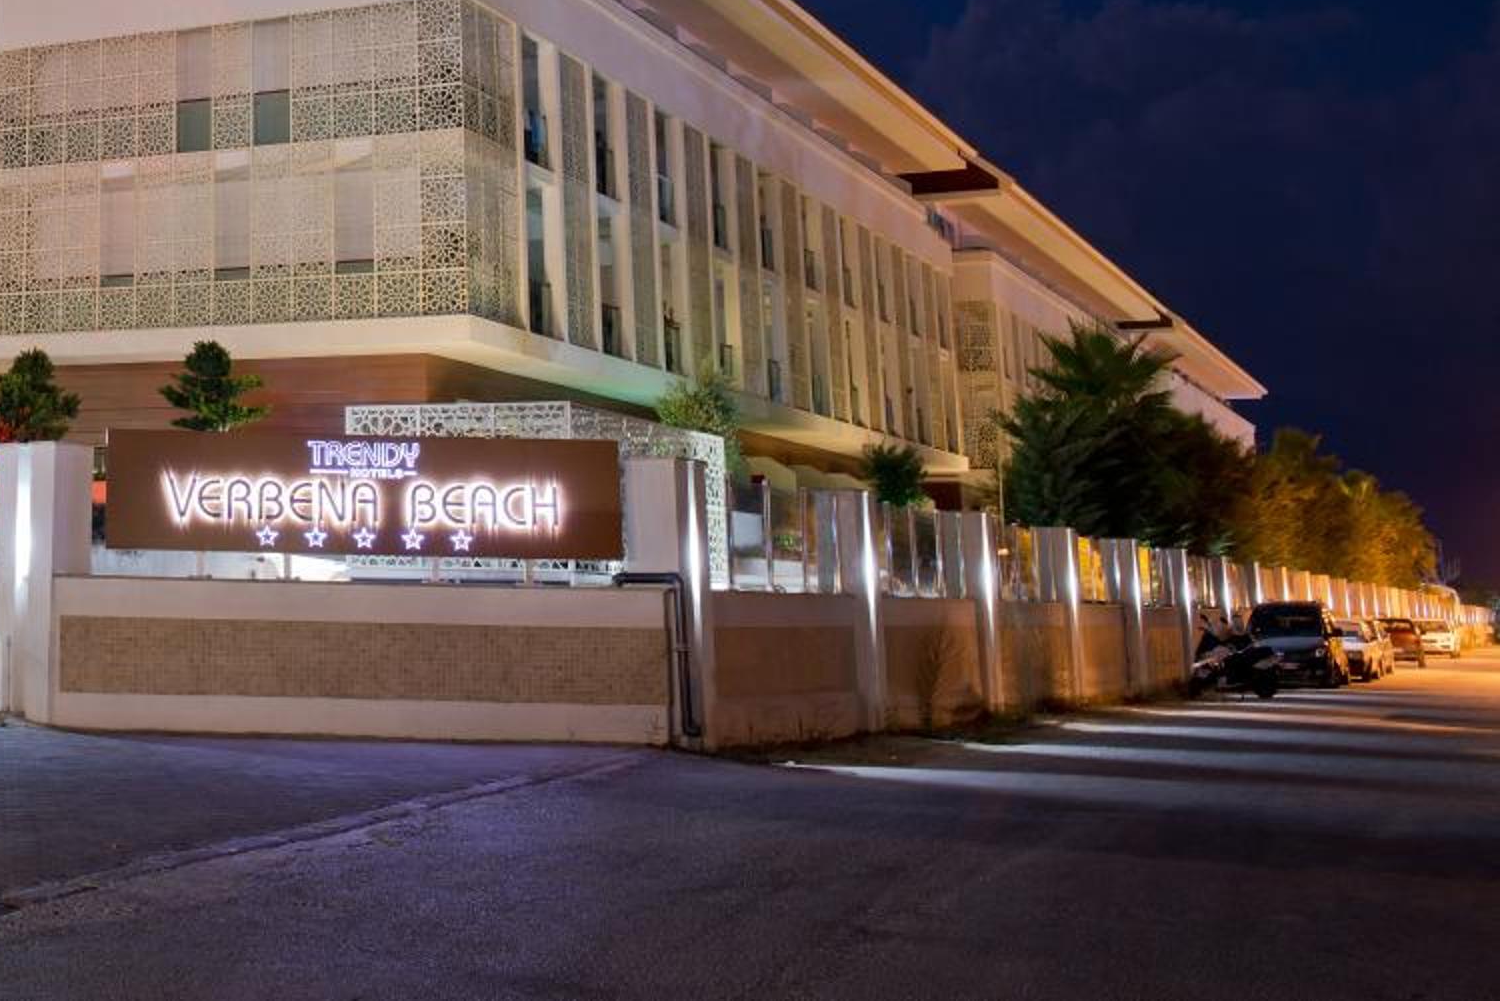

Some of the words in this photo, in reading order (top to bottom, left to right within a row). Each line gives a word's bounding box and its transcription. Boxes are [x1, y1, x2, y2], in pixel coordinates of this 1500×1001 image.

[307, 440, 420, 468] TRENDY
[162, 472, 377, 524] VERBENA
[409, 482, 560, 527] BEACH
